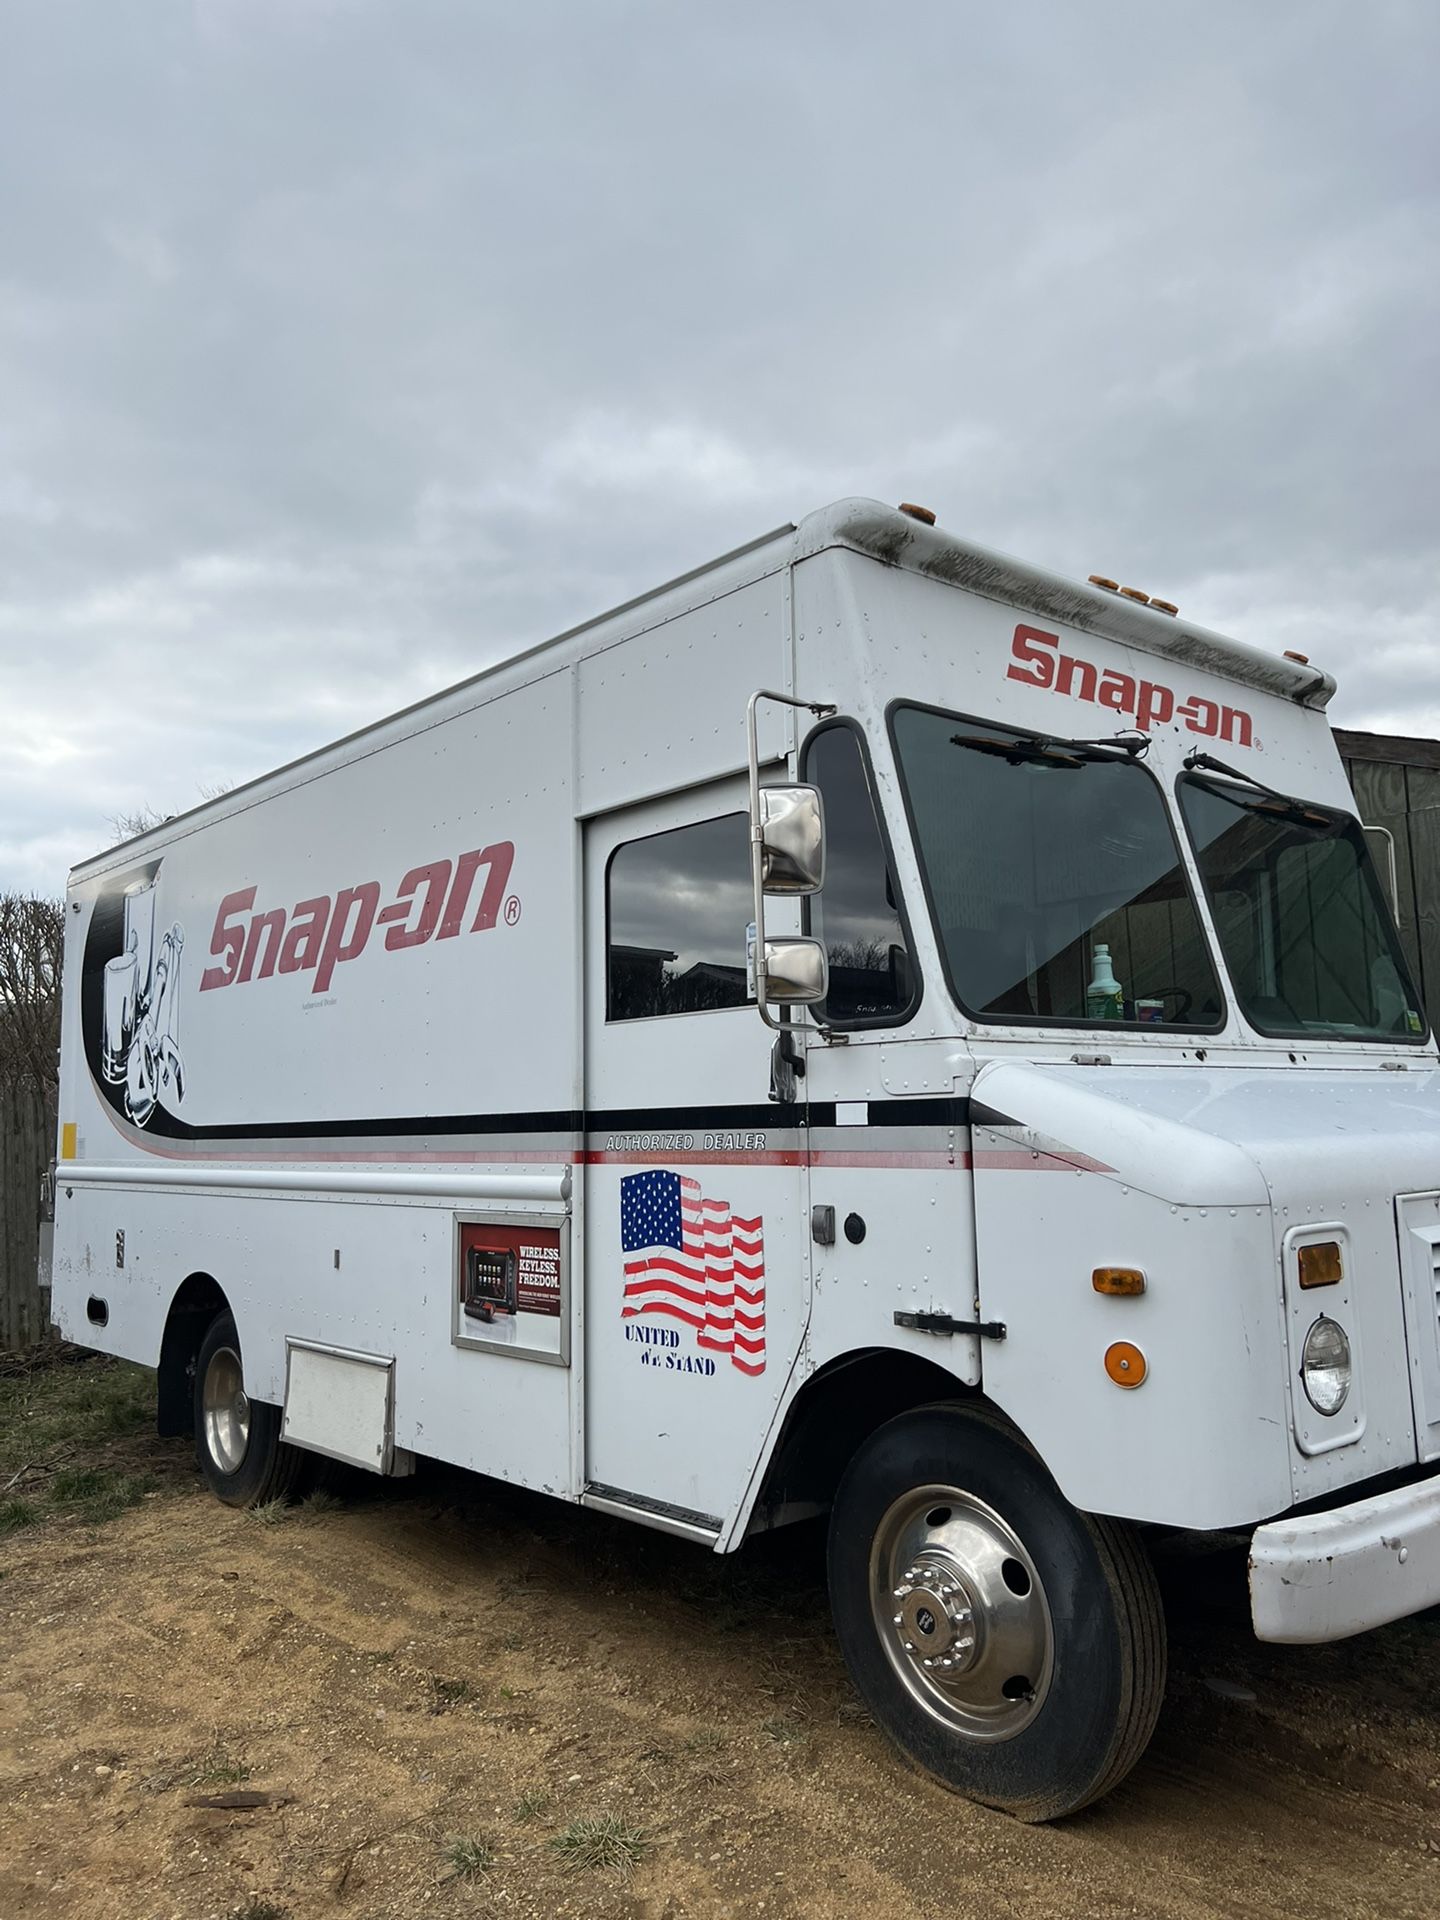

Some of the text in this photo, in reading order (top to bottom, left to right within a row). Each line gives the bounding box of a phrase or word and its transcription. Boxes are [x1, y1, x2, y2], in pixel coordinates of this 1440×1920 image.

[1006, 623, 1253, 748] Snap-on
[199, 840, 515, 994] Snap-on
[606, 1132, 766, 1151] AUTHORIZED DEALER
[519, 1246, 560, 1260] WIRELESS.
[519, 1259, 557, 1274] KEYLESS.
[518, 1272, 560, 1288] FREEDOM.
[625, 1325, 680, 1348] UNITED
[665, 1352, 716, 1377] STAND
